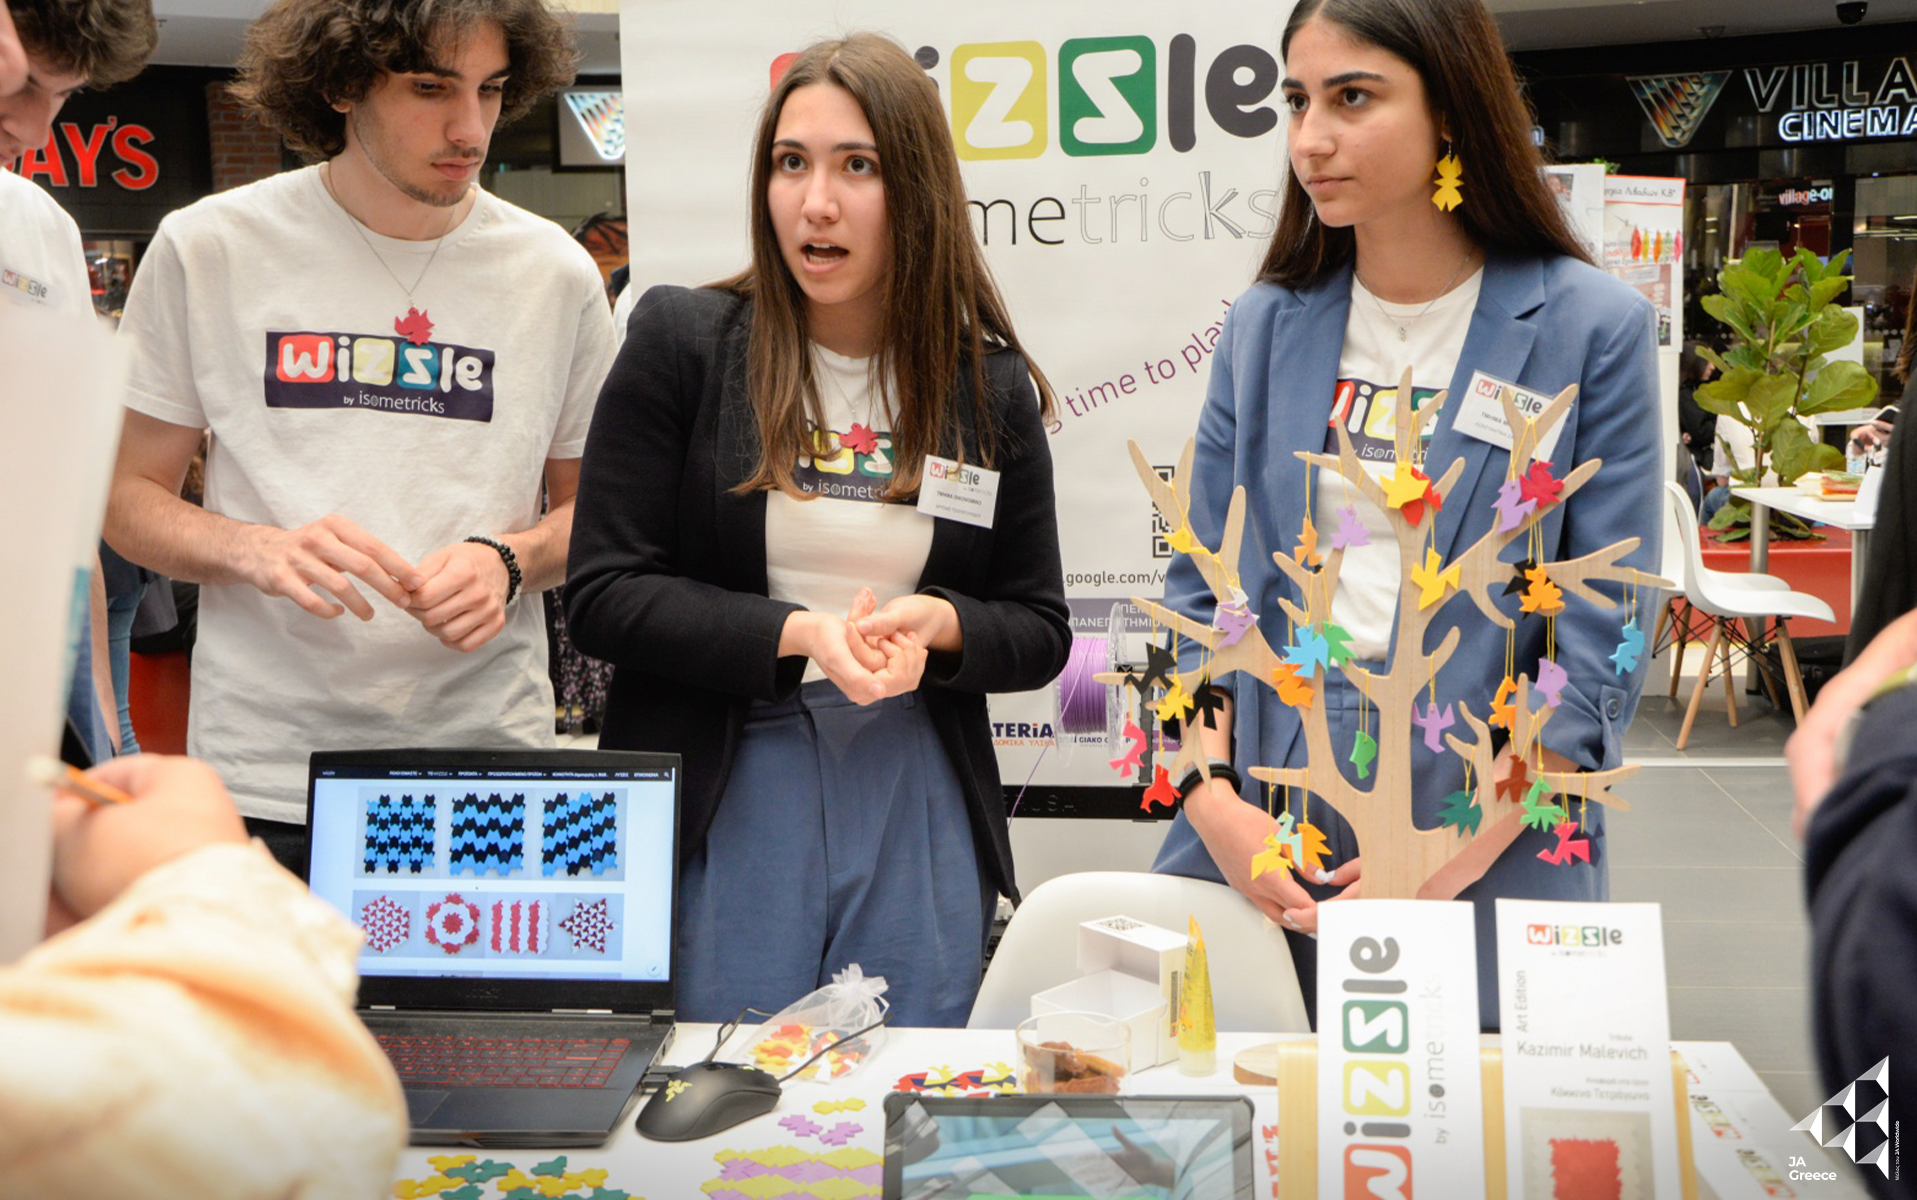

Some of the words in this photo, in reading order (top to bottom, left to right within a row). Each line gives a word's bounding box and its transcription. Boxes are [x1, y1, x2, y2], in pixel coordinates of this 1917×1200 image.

[6, 116, 159, 190] AY'S
[968, 171, 1278, 247] metricks
[343, 396, 355, 406] by
[358, 391, 445, 413] isometricks
[1065, 374, 1137, 417] time
[1144, 358, 1176, 384] to
[1514, 970, 1528, 1011] Edition
[1515, 1012, 1528, 1033] Art
[1517, 1040, 1574, 1058] Kazimir
[1580, 1043, 1649, 1061] Malevich
